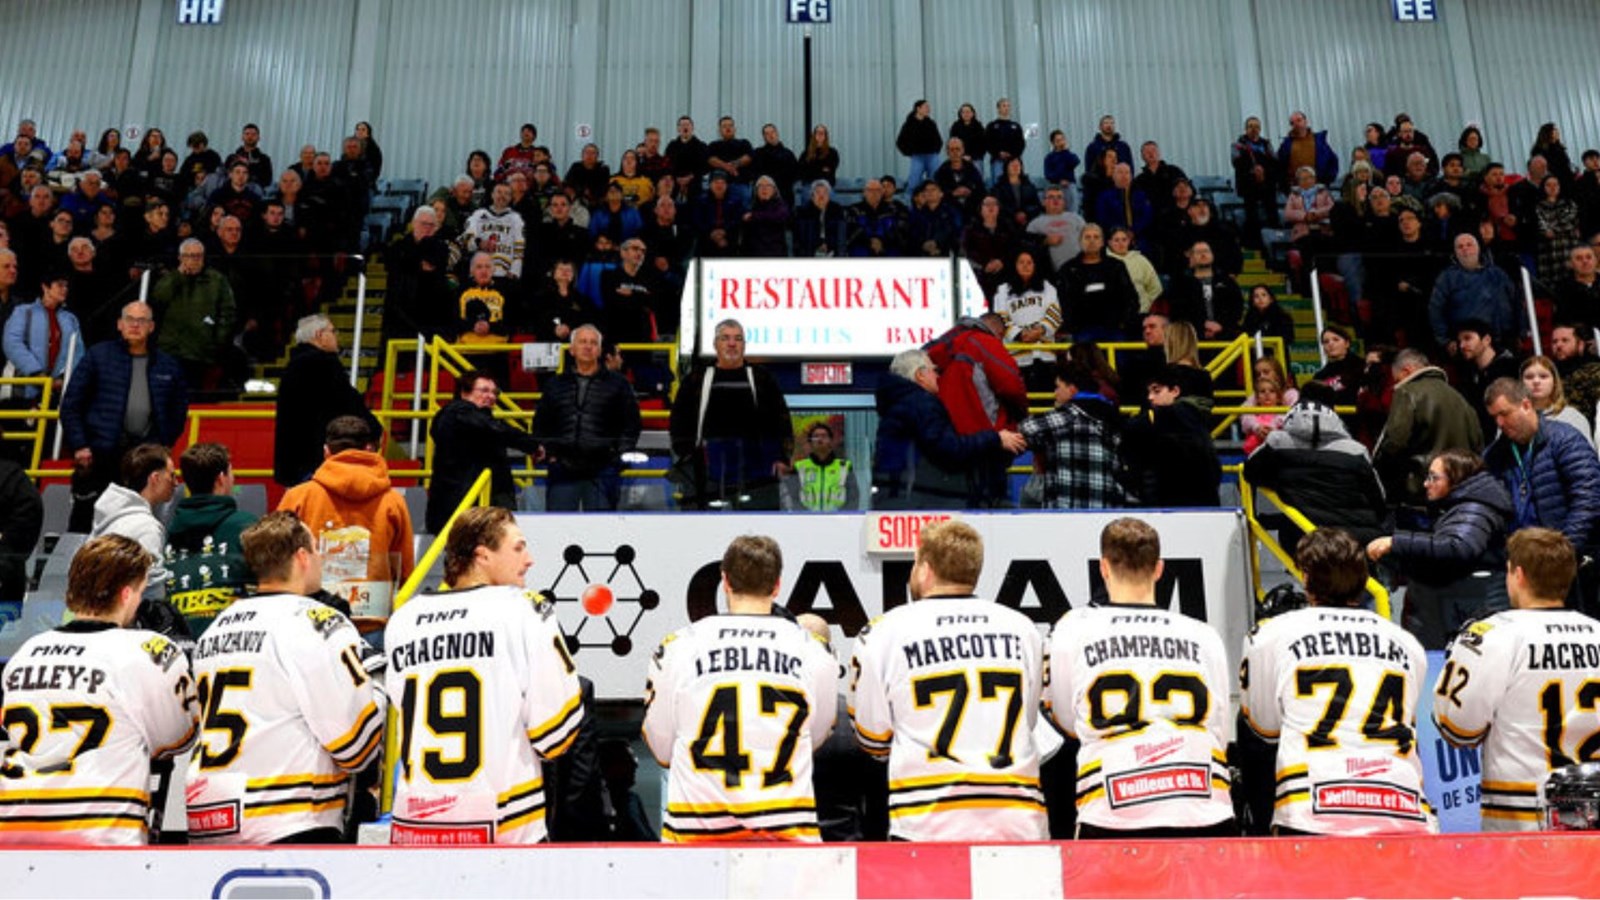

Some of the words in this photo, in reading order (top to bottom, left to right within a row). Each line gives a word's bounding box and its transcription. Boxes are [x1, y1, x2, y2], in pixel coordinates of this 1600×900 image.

[179, 0, 222, 23] HH
[790, 0, 828, 21] FG
[1398, 0, 1434, 20] EE
[720, 277, 935, 309] RESTAURANT
[886, 326, 934, 344] BAR
[879, 514, 952, 548] SOR
[392, 630, 495, 673] CHAGNON
[1084, 635, 1201, 668] CHAMPAGNE
[1288, 631, 1410, 671] TREMBLA
[1528, 643, 1600, 670] LACRO
[1436, 660, 1470, 709] 12
[400, 666, 483, 784] 19
[911, 667, 1023, 768] 77
[1294, 664, 1416, 757] 74
[690, 682, 809, 790] 47
[1443, 788, 1462, 810] DE
